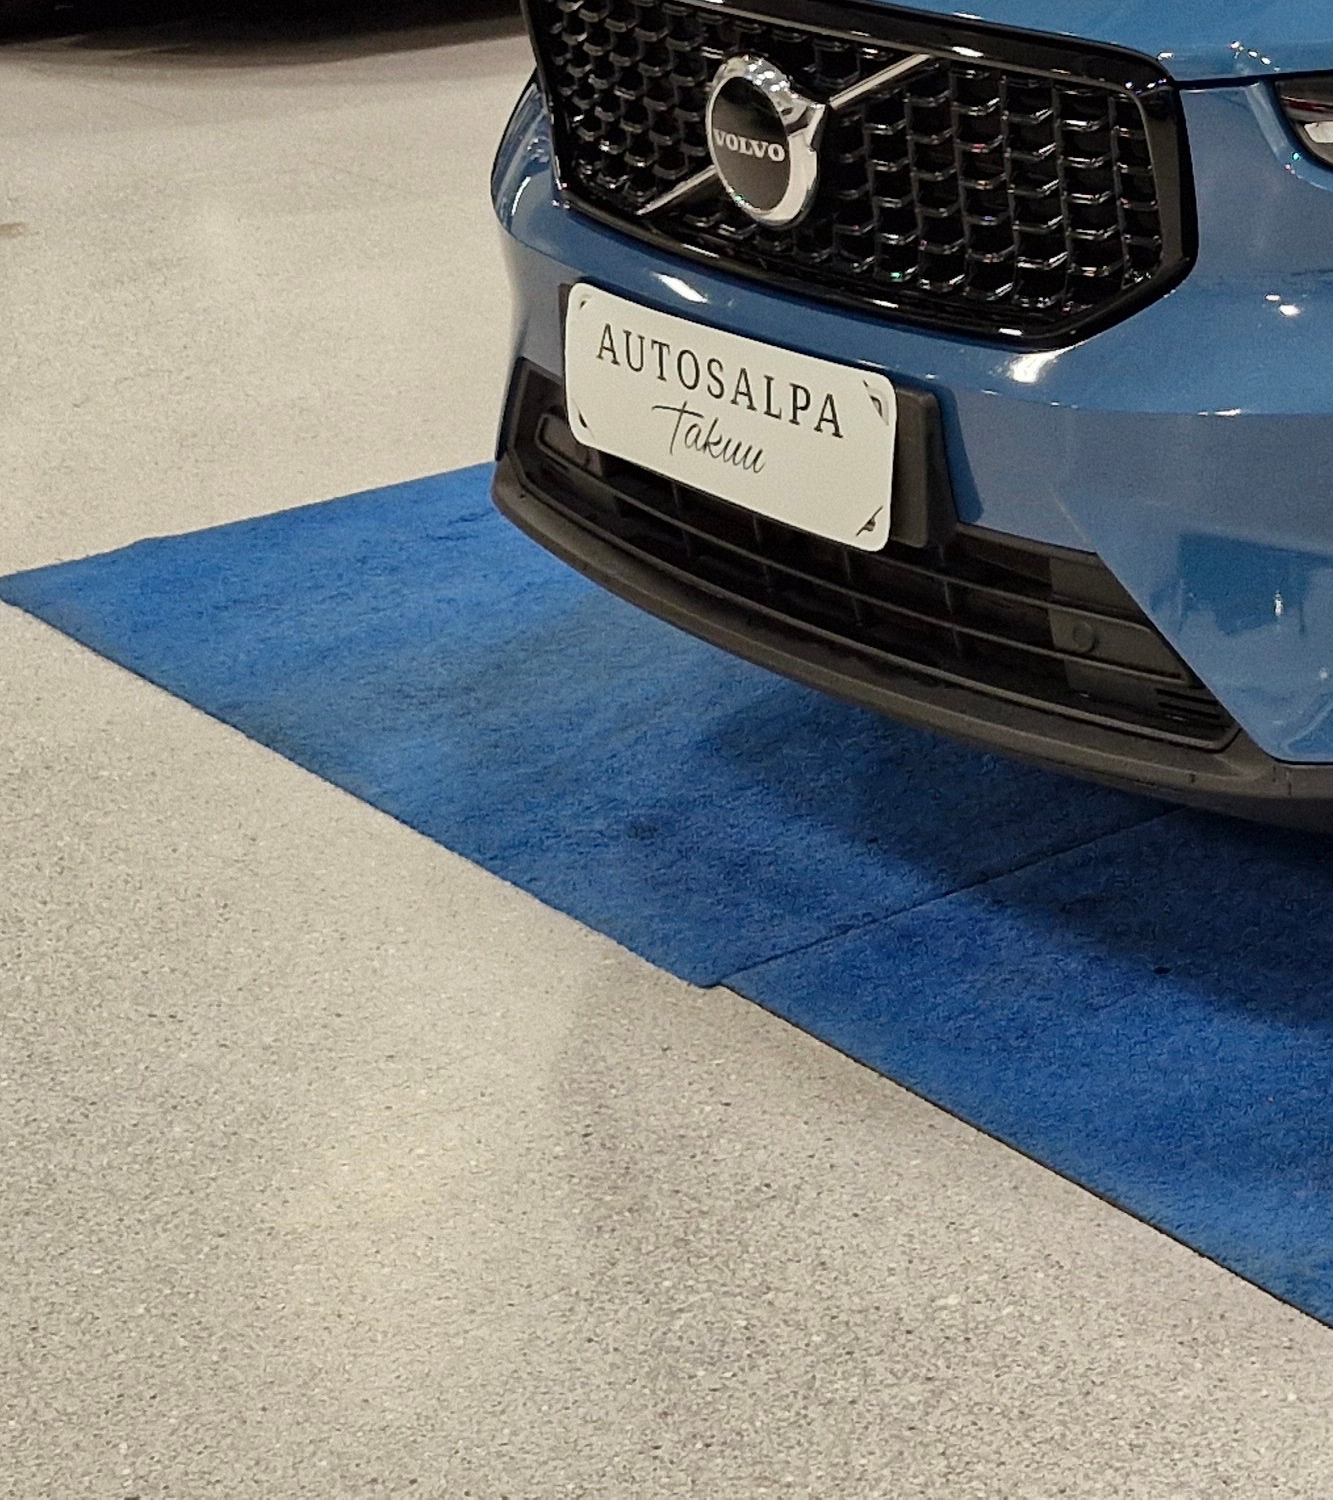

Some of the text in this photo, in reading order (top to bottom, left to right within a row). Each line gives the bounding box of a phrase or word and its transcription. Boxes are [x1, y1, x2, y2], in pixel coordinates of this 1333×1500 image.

[712, 127, 786, 162] VOLVO
[595, 322, 845, 440] AUTOSALPA
[651, 401, 766, 474] Takuu
